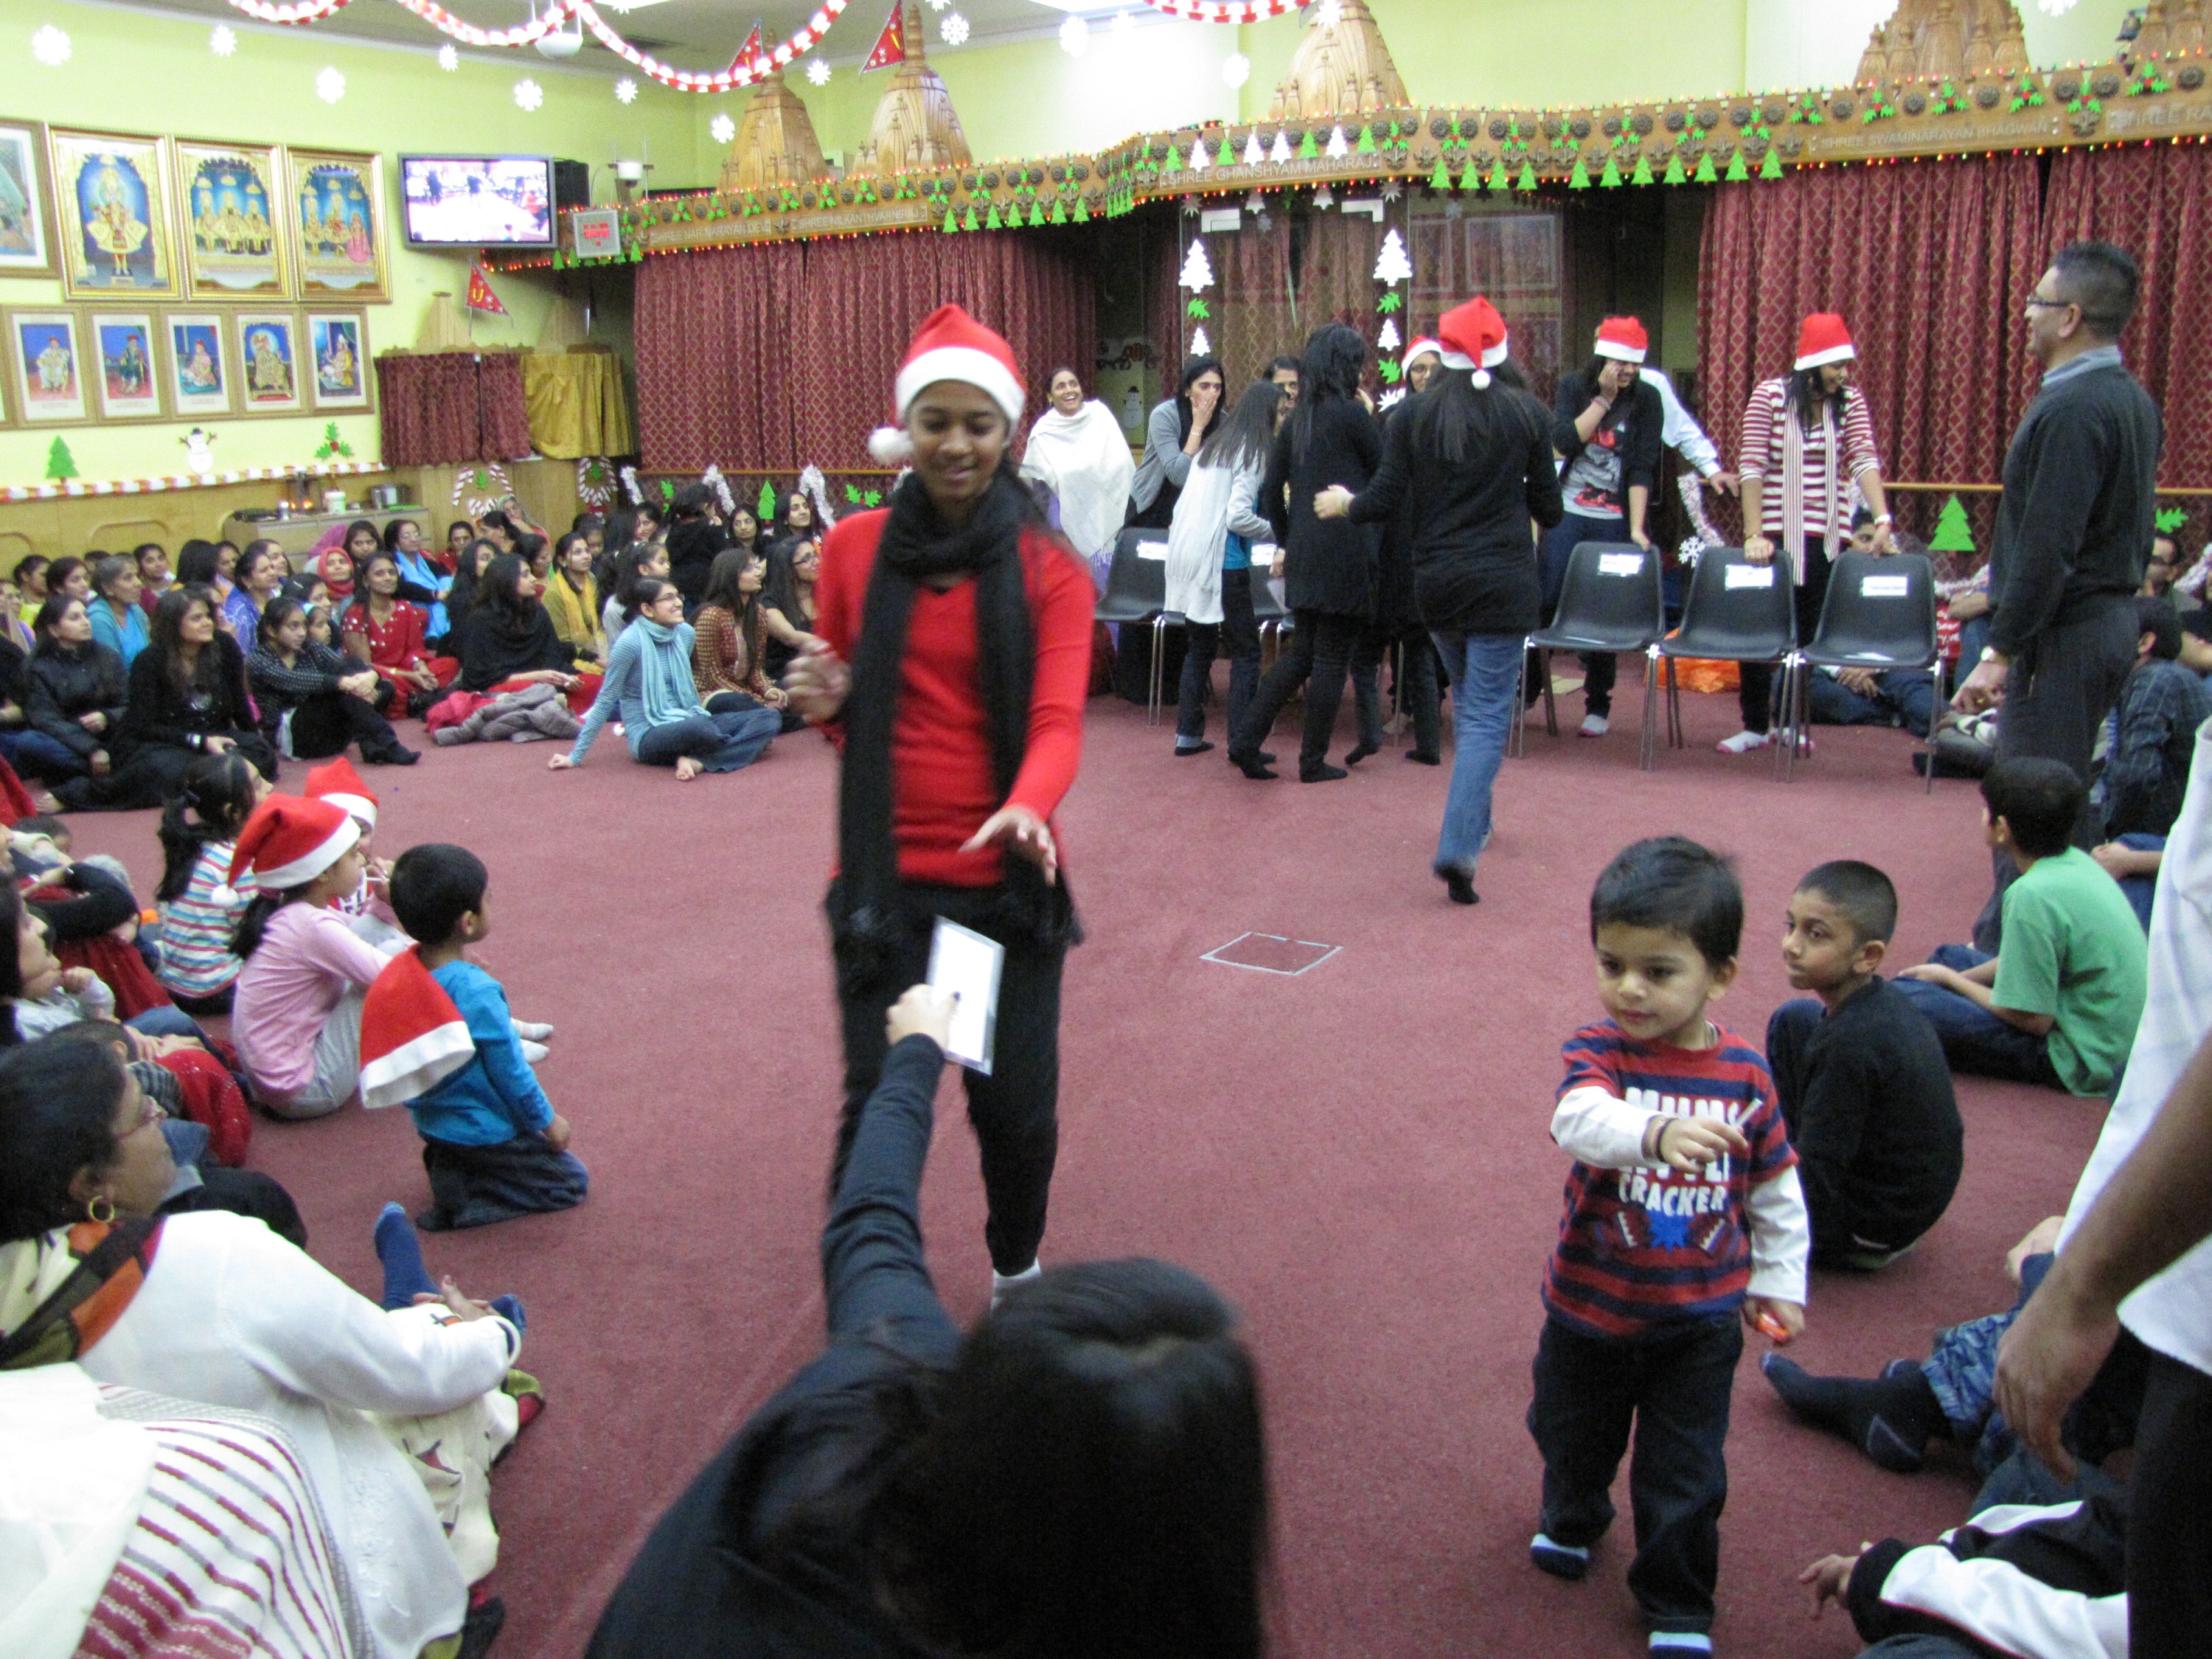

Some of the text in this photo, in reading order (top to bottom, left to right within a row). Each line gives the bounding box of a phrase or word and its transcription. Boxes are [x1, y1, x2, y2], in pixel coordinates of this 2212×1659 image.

[1821, 136, 1864, 148] SHREE
[1868, 128, 1973, 146] SWAMINARAYAN
[1169, 155, 1373, 185] SHREE GHANSHYAM MAHARAJ
[799, 209, 919, 229] SHREE NILKANTHVARNIRAJ
[653, 230, 683, 243] SHREE
[1619, 1172, 1726, 1217] CRACKER
